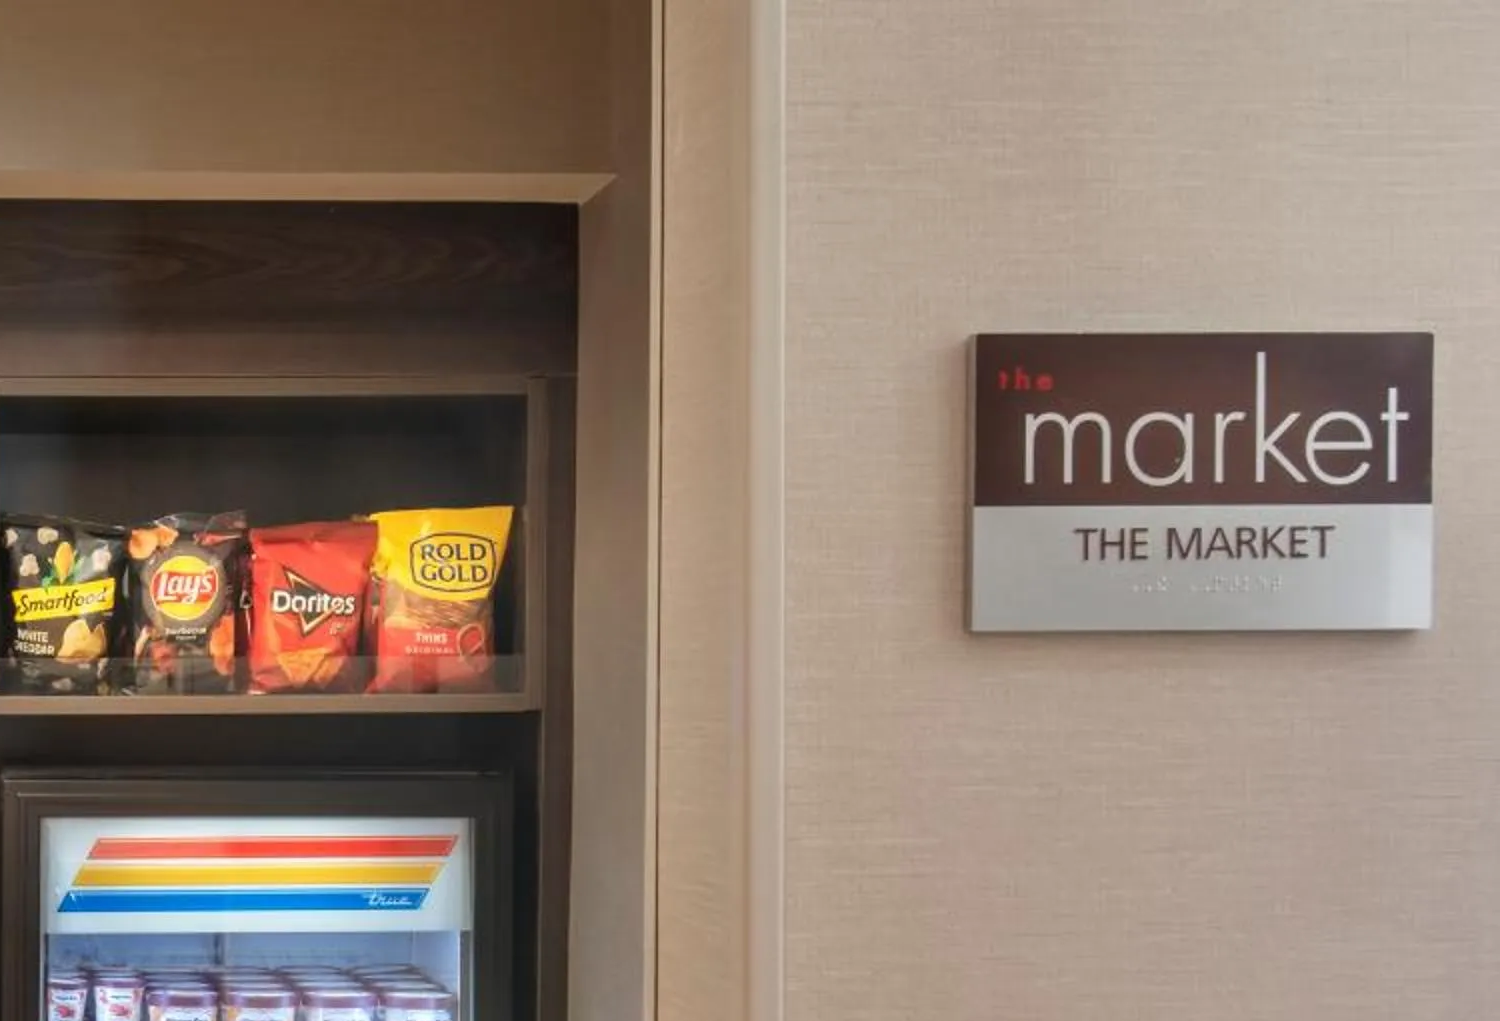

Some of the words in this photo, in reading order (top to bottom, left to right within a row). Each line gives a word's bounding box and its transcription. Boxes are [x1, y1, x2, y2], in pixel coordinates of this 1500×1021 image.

[999, 368, 1054, 391] the
[1024, 351, 1410, 487] market
[420, 543, 487, 562] ROLD
[1073, 527, 1149, 561] THE
[1165, 525, 1336, 560] MARKET
[420, 564, 488, 583] GOLD
[19, 586, 108, 616] Smartfood
[272, 590, 355, 615] Doritos
[17, 629, 49, 643] WHITE
[416, 632, 448, 643] THINS
